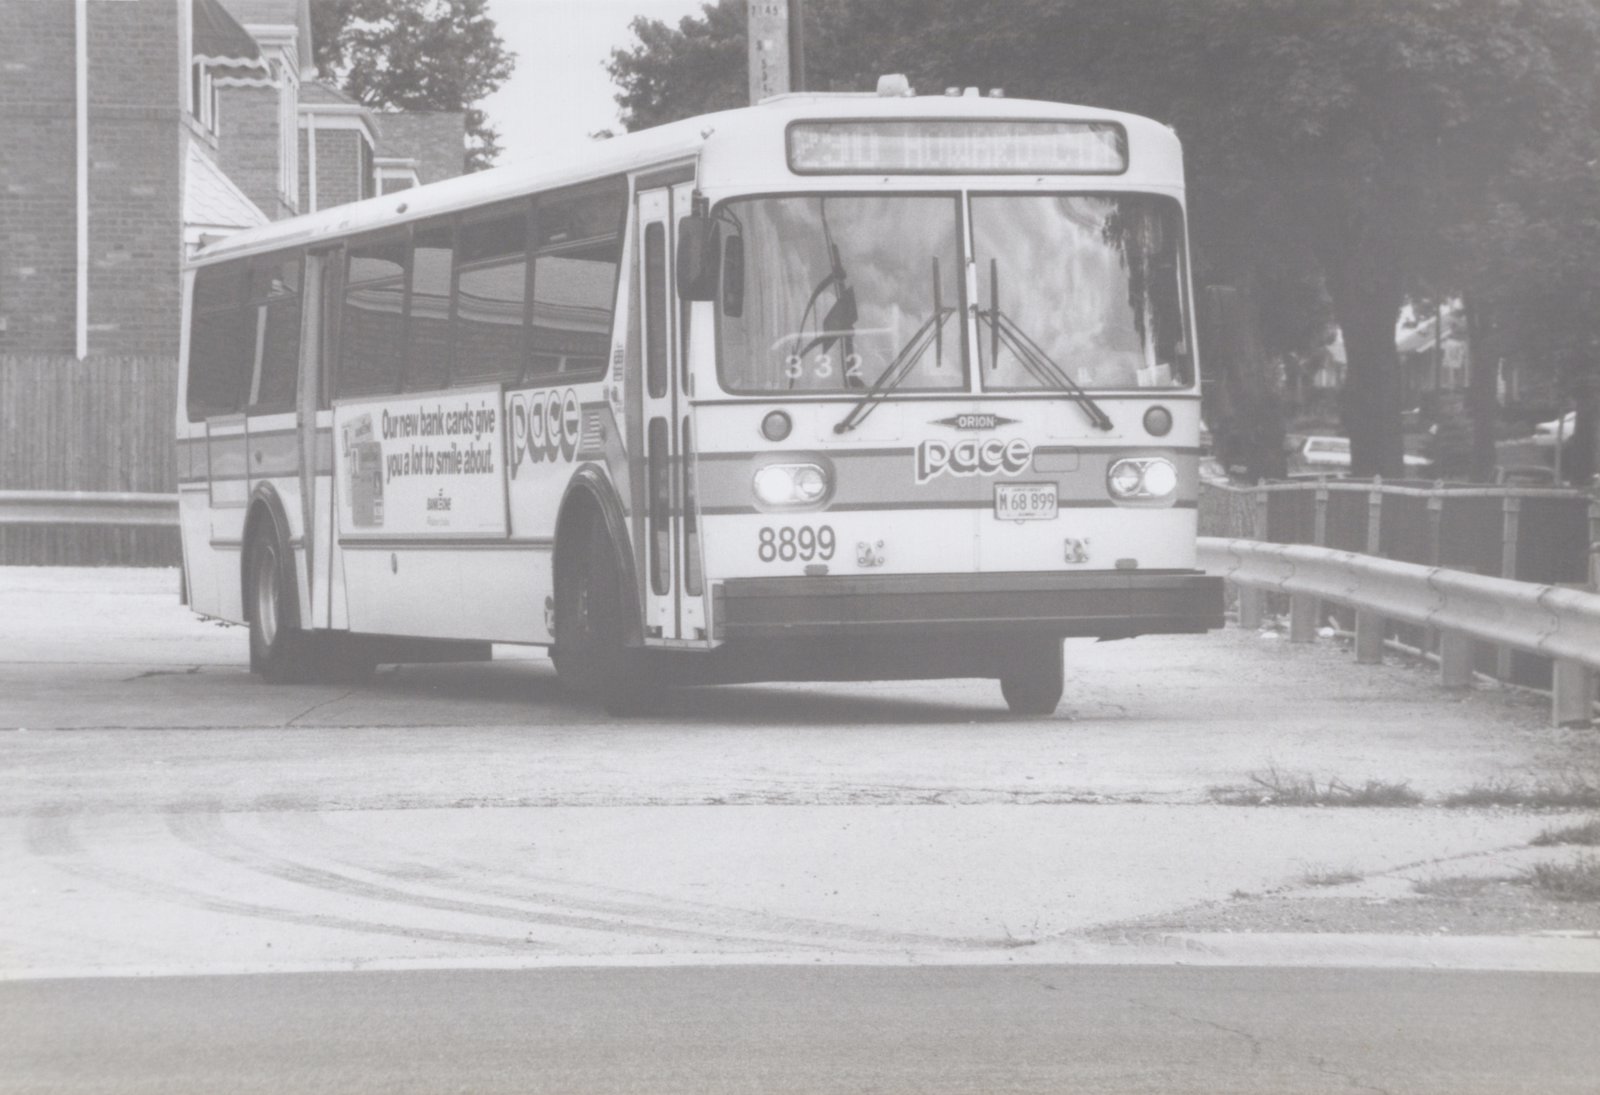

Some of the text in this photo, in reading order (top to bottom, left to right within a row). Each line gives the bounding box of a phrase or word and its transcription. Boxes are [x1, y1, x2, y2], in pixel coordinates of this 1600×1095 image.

[785, 354, 863, 378] 332
[382, 409, 398, 440] Our
[399, 414, 419, 437] new
[420, 404, 444, 436] bank
[446, 402, 474, 435] cards
[476, 400, 495, 441] give
[509, 389, 581, 480] pace
[958, 415, 995, 428] ORION
[387, 442, 494, 484] you a lot to smile about.
[915, 437, 1033, 485] pace
[999, 493, 1055, 511] M 68 899
[758, 525, 836, 562] 8899
